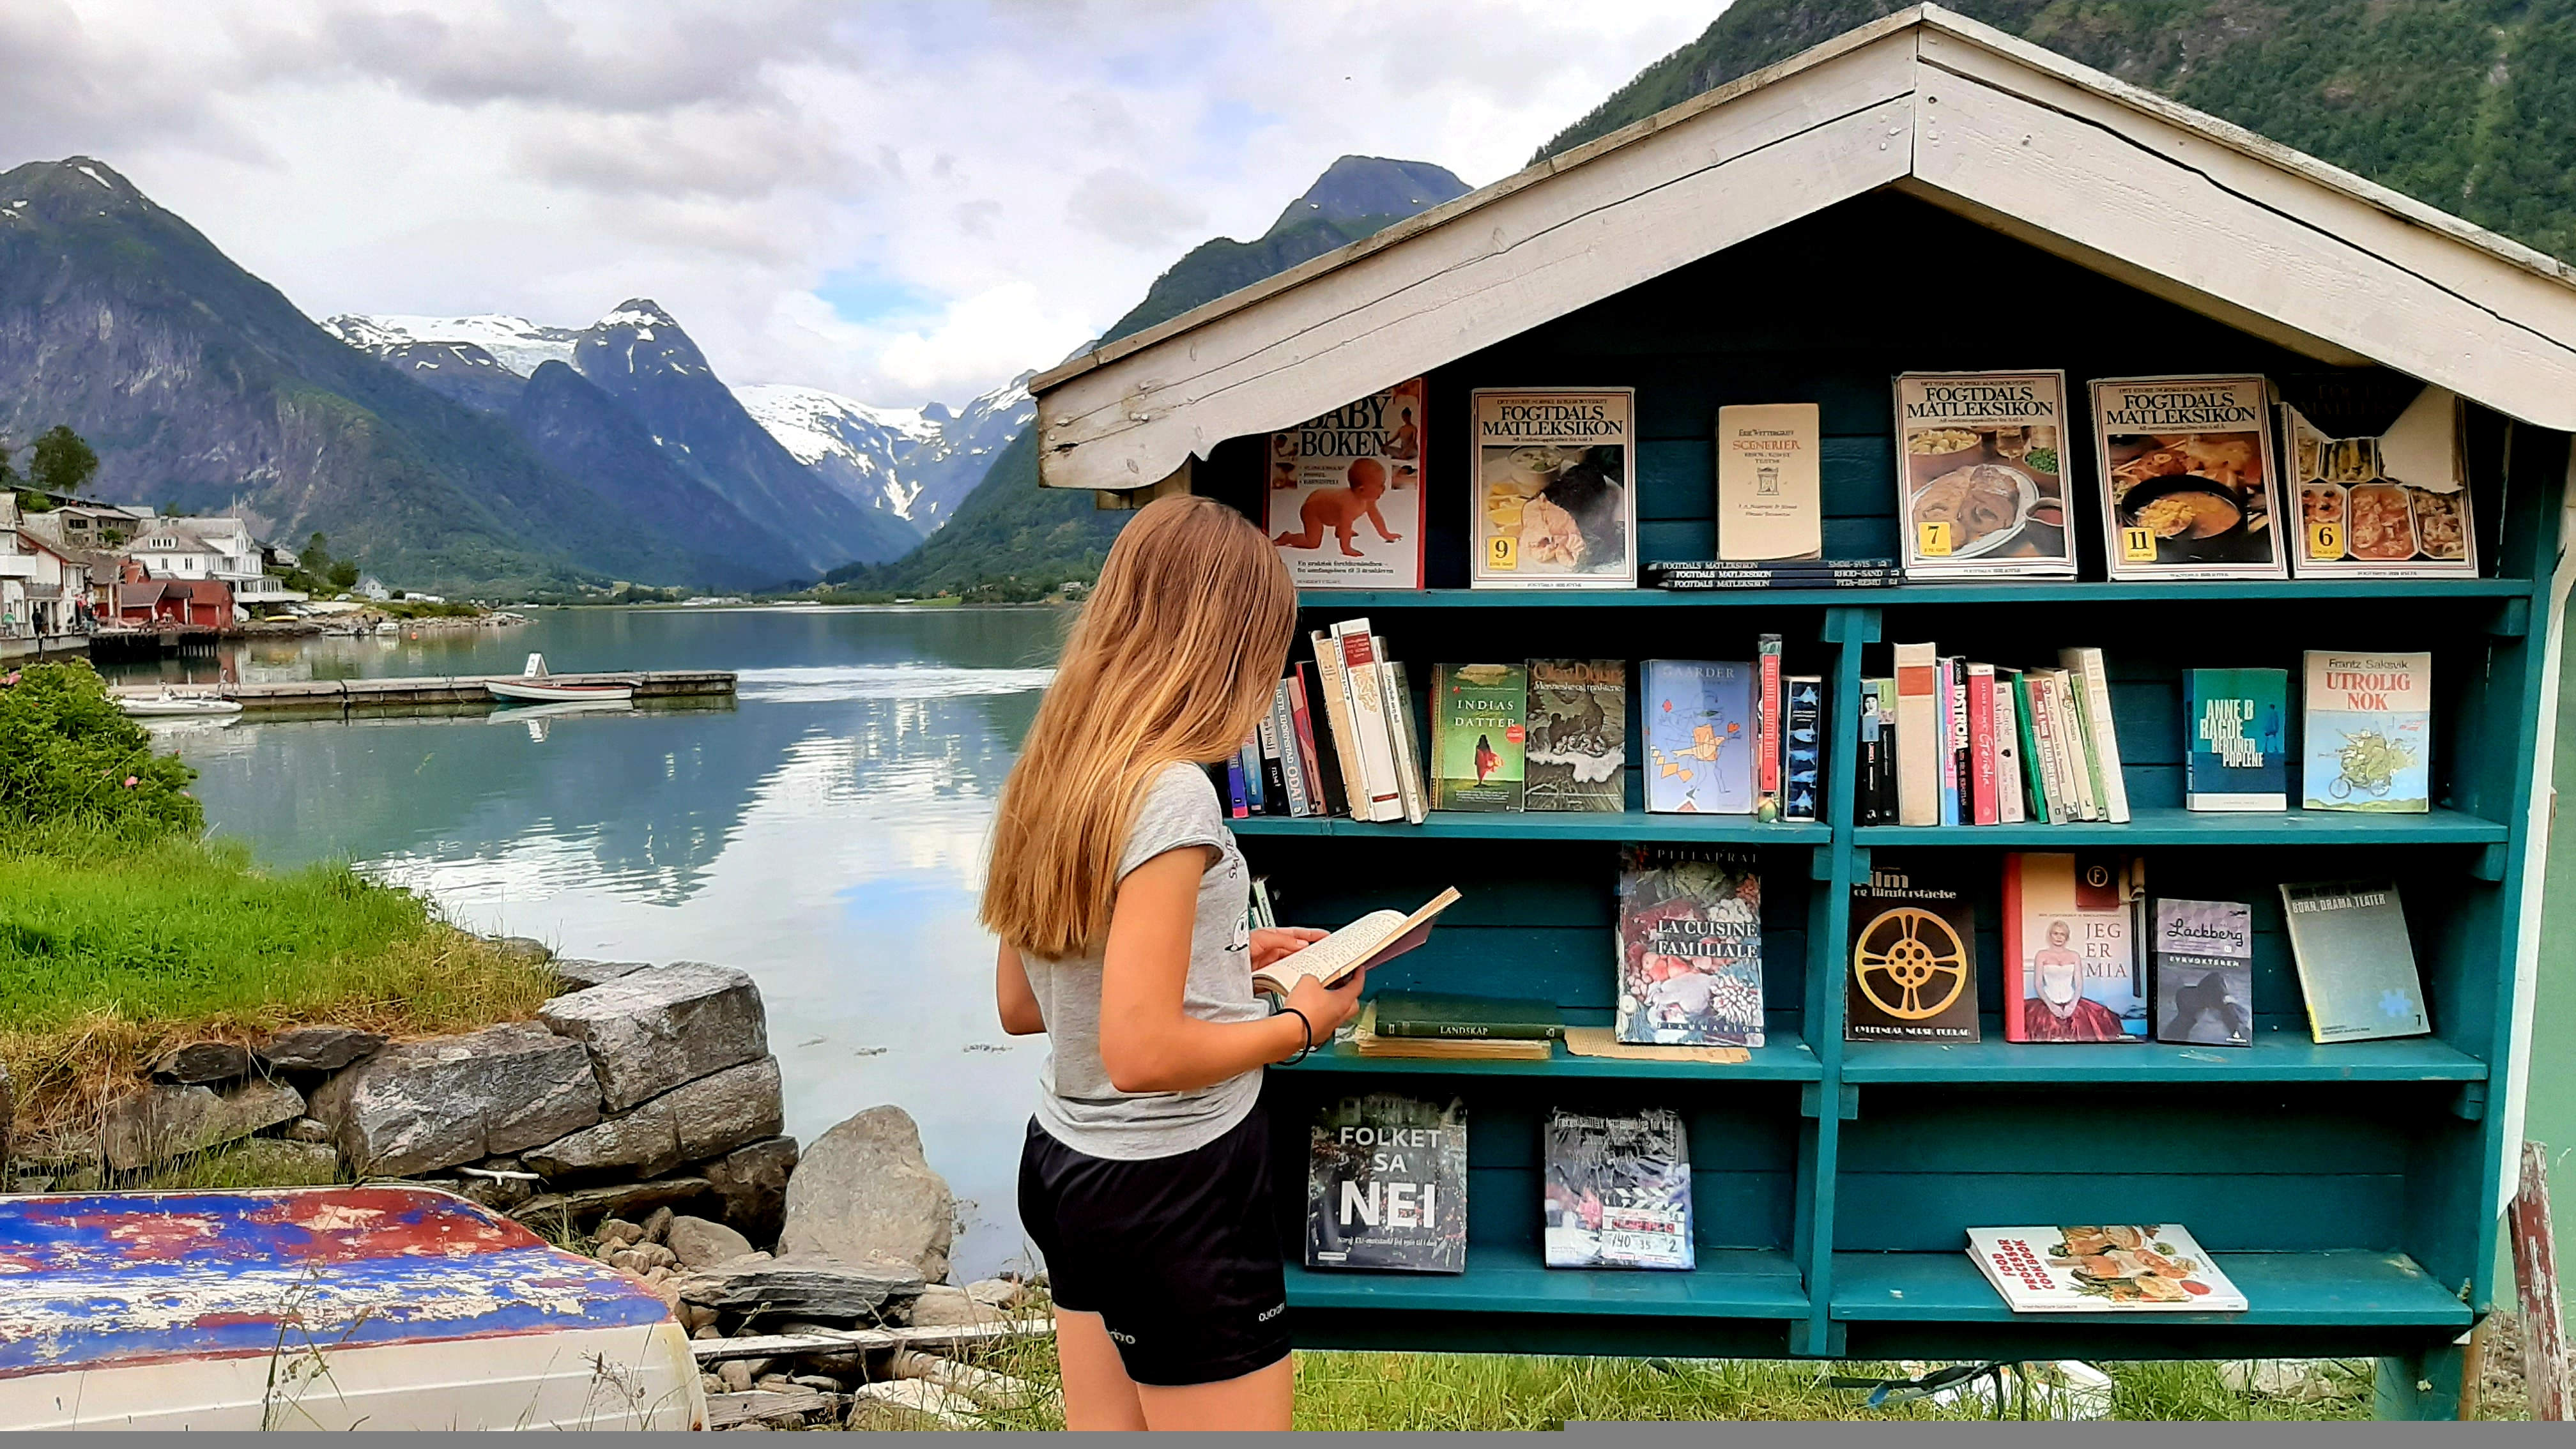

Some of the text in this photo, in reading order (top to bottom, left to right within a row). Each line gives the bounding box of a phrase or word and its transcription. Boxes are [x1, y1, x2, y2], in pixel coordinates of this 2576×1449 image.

[1926, 386, 2033, 401] FOGTDALS
[2124, 392, 2234, 409] FOGTDALS
[1501, 406, 1604, 420] FOGTDALS
[1906, 401, 2053, 418] MATLEKSIKON
[2106, 407, 2256, 424] MATLEKSIKON
[1482, 420, 1623, 436] MATLEKSIKON
[1301, 431, 1390, 457] BOKEN
[1928, 525, 1940, 544] 7
[2128, 532, 2150, 549] 11
[2319, 527, 2334, 546] 6
[1495, 540, 1508, 558] 9
[2329, 659, 2362, 669] Frantz
[2326, 672, 2411, 691] UTROLIG
[1458, 700, 1514, 710] INDIAS
[2206, 700, 2254, 720] ANNE B
[2348, 693, 2388, 710] NOK
[1455, 717, 1516, 728] DATTER
[2200, 719, 2243, 739] RAGDE
[2223, 752, 2263, 767] POPLENE
[1287, 766, 1303, 802] ODA!
[1657, 919, 1758, 937] LA CUISINE
[2085, 923, 2121, 939] JEG
[1658, 940, 1758, 958] FAMILIALE
[2085, 942, 2112, 958] ER
[2085, 963, 2127, 977] MIA
[1440, 1026, 1489, 1036] LANDSKAP
[1340, 1126, 1442, 1148] FOLKET
[1374, 1153, 1408, 1173] SA
[1340, 1180, 1436, 1229] NEI
[1612, 1234, 1631, 1248] 140
[1668, 1239, 1678, 1254] 2
[1992, 1254, 2016, 1276] FOOD
[1997, 1239, 2042, 1290] PROCESSOR
[2012, 1239, 2055, 1287] COOKBOOK
